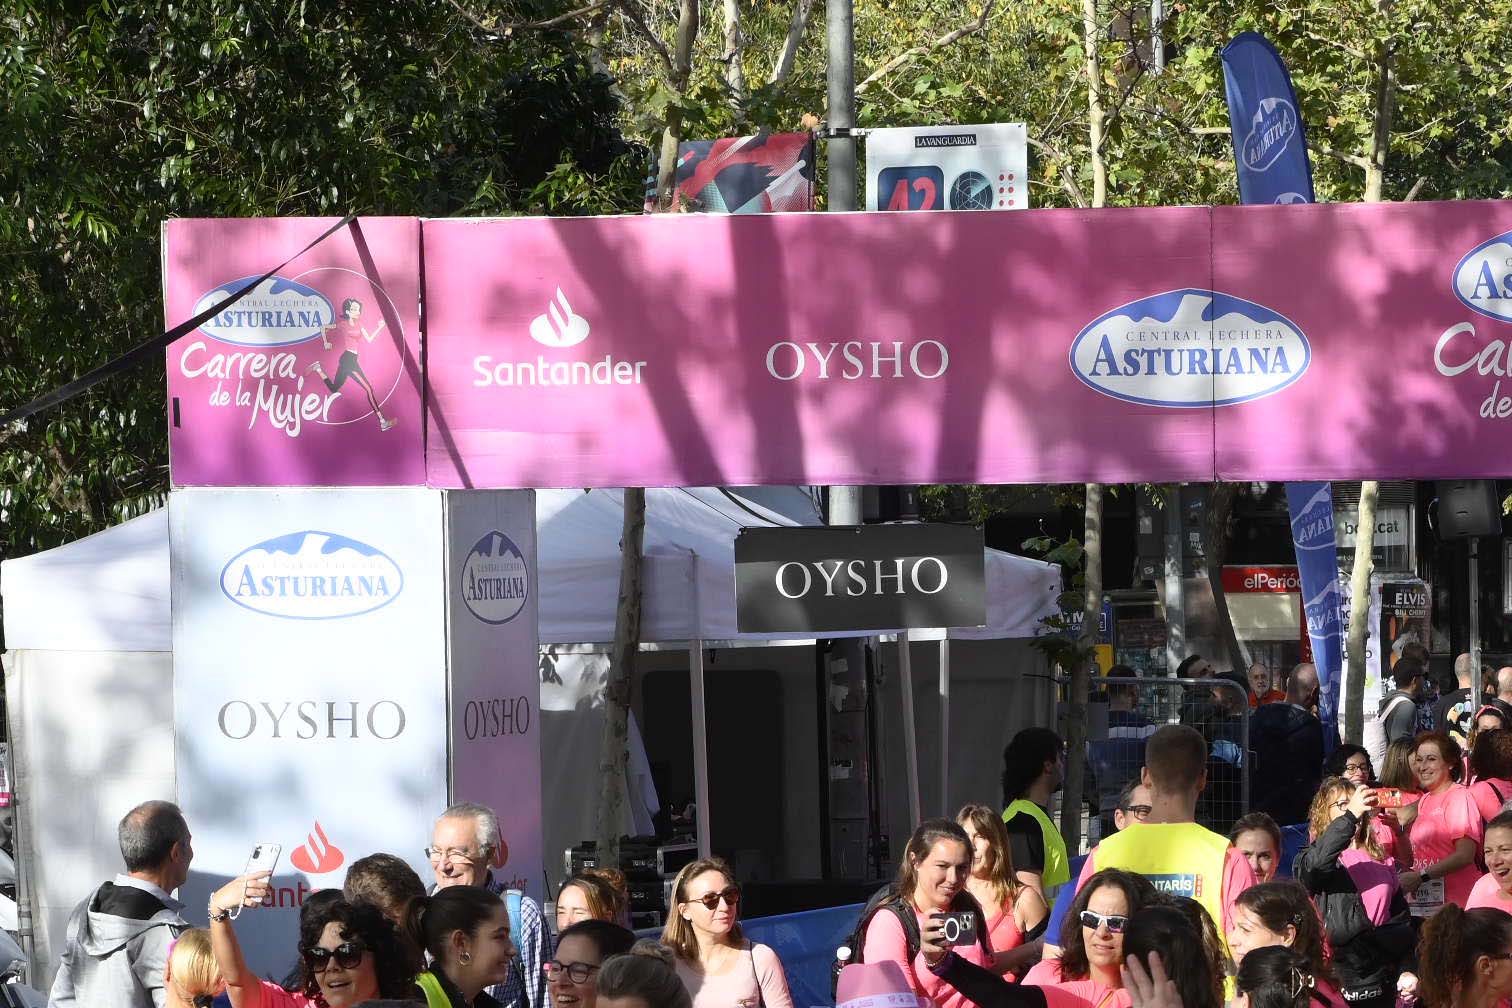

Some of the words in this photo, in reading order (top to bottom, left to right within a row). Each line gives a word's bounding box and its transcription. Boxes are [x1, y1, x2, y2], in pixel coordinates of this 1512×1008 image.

[926, 135, 975, 146] VANGUARDIA
[202, 303, 323, 328] ASTURIANA
[1126, 330, 1200, 342] CENTRAL
[1208, 328, 1283, 342] LECHERA
[180, 341, 296, 379] Carrera
[473, 355, 647, 386] Santander
[766, 340, 949, 381] OYSHO
[1089, 335, 1291, 377] ASTURIANA
[209, 384, 231, 407] de
[234, 383, 251, 407] la
[248, 380, 342, 438] Mujer
[1344, 521, 1399, 535] b.cat
[235, 564, 390, 598] ASTURIANA
[467, 566, 525, 601] ASTURIANA
[775, 556, 948, 598] OYSHO
[1395, 592, 1426, 605] ELVIS
[218, 700, 407, 740] OYSHO
[464, 696, 530, 740] OYSHO
